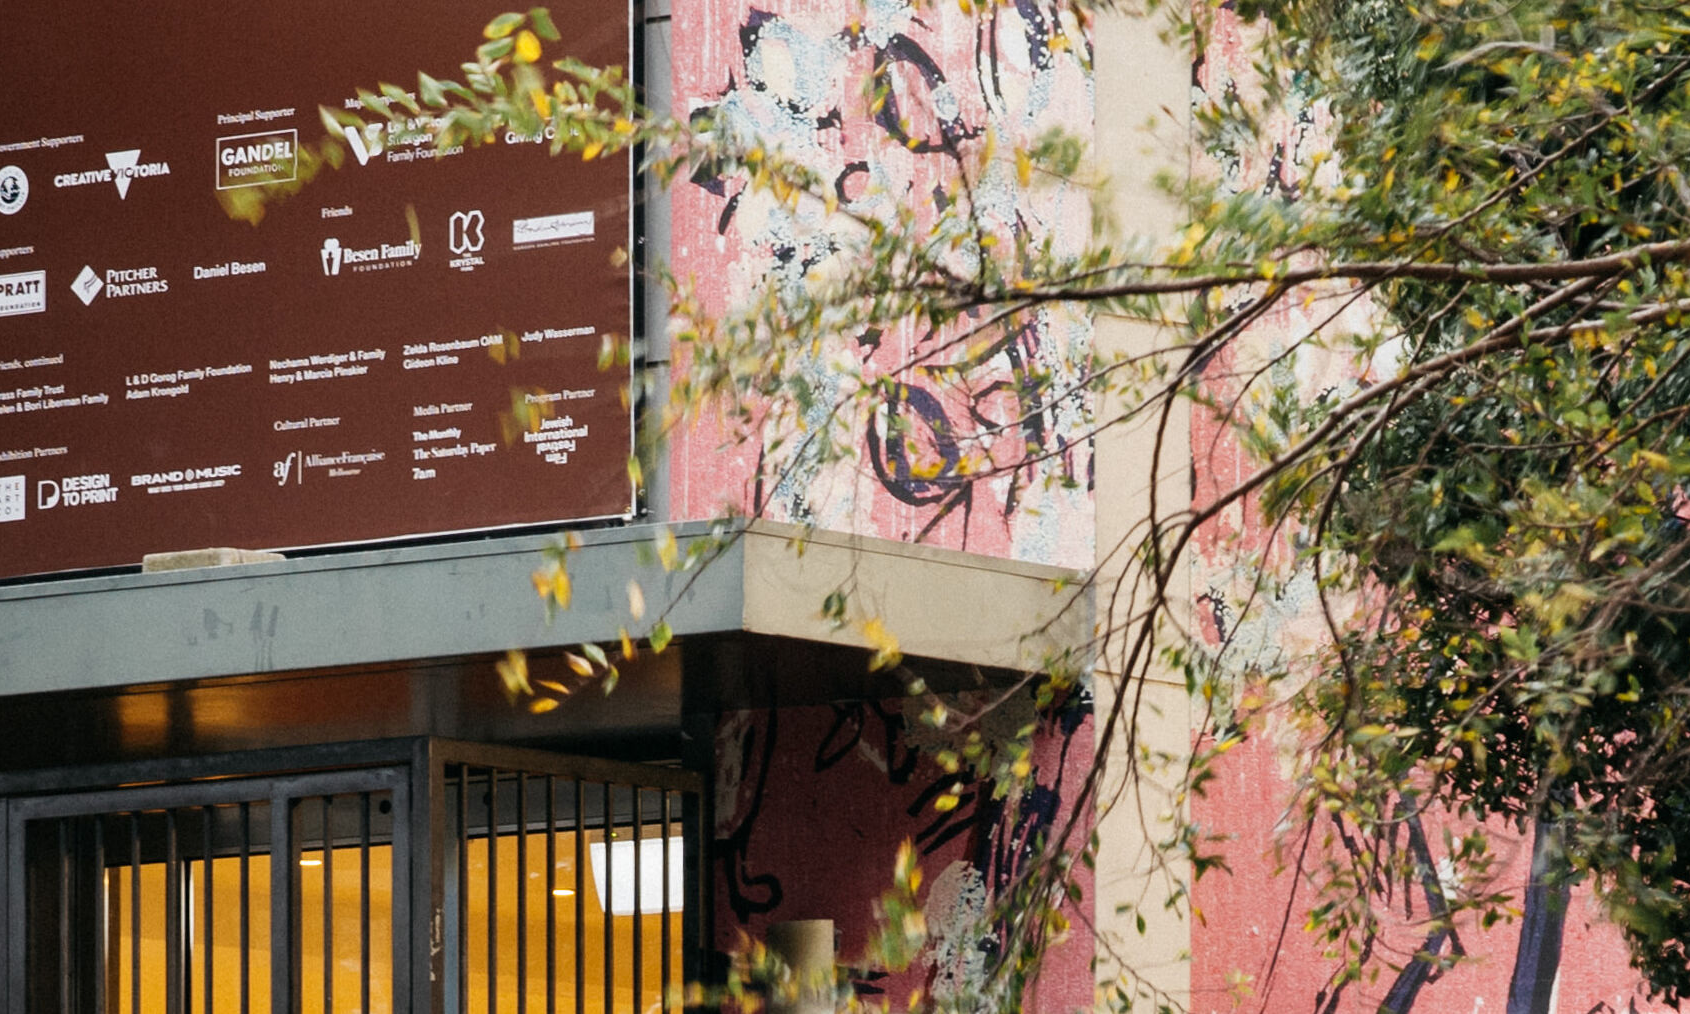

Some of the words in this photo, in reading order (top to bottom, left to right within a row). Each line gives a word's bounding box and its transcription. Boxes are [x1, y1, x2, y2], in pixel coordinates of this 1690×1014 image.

[217, 110, 253, 124] Principal
[255, 108, 295, 120] Supporter
[41, 135, 84, 148] Supporters
[221, 141, 293, 166] GANDEL
[387, 149, 415, 162] Family
[54, 169, 111, 188] CREATIVE
[111, 162, 171, 179] VICTORIA
[321, 205, 353, 219] Friends
[343, 247, 379, 264] Besen
[380, 240, 421, 260] Family
[353, 260, 413, 272] FOUNDATION
[449, 256, 485, 268] KRYSTAL
[106, 267, 157, 283] PITCHER
[193, 263, 229, 280] Daniel
[231, 261, 266, 276] Besen
[106, 280, 169, 298] PARTNERS
[521, 330, 543, 343] Judy
[544, 326, 595, 339] Wasserman
[403, 344, 427, 356] Zelda
[428, 339, 479, 352] Rosenbaum
[480, 334, 503, 346] OAM
[24, 354, 64, 368] continued
[349, 351, 356, 361] &
[357, 348, 386, 360] Family
[403, 358, 435, 370] Gideon
[436, 355, 459, 366] Kline
[125, 376, 132, 386] L
[133, 375, 140, 385] &
[141, 374, 149, 384] D
[177, 368, 205, 380] Family
[205, 364, 252, 377] Foundation
[269, 374, 294, 384] Henry
[295, 370, 303, 381] &
[303, 368, 333, 380] Marcia
[16, 387, 43, 398] Family
[43, 384, 65, 395] Trust
[126, 389, 150, 399] Adam
[524, 393, 561, 404] Program
[563, 389, 596, 400] Partner
[16, 402, 23, 412] &
[81, 392, 109, 405] Family
[413, 405, 439, 416] Media
[440, 402, 473, 413] Partner
[273, 418, 308, 431] Cultural
[309, 417, 340, 427] Partner
[540, 415, 573, 430] Jewish
[413, 432, 428, 441] The
[428, 428, 461, 440] Monthly
[524, 425, 588, 443] International
[34, 446, 68, 458] Partners
[413, 449, 429, 460] The
[430, 444, 468, 458] Saturday
[470, 442, 497, 456] Paper
[131, 471, 184, 486] BRAND
[195, 464, 241, 479] MUSIC
[412, 468, 436, 480] 7am
[62, 474, 110, 492] DESIGN
[62, 492, 80, 507] TO
[81, 487, 119, 505] PRINT
